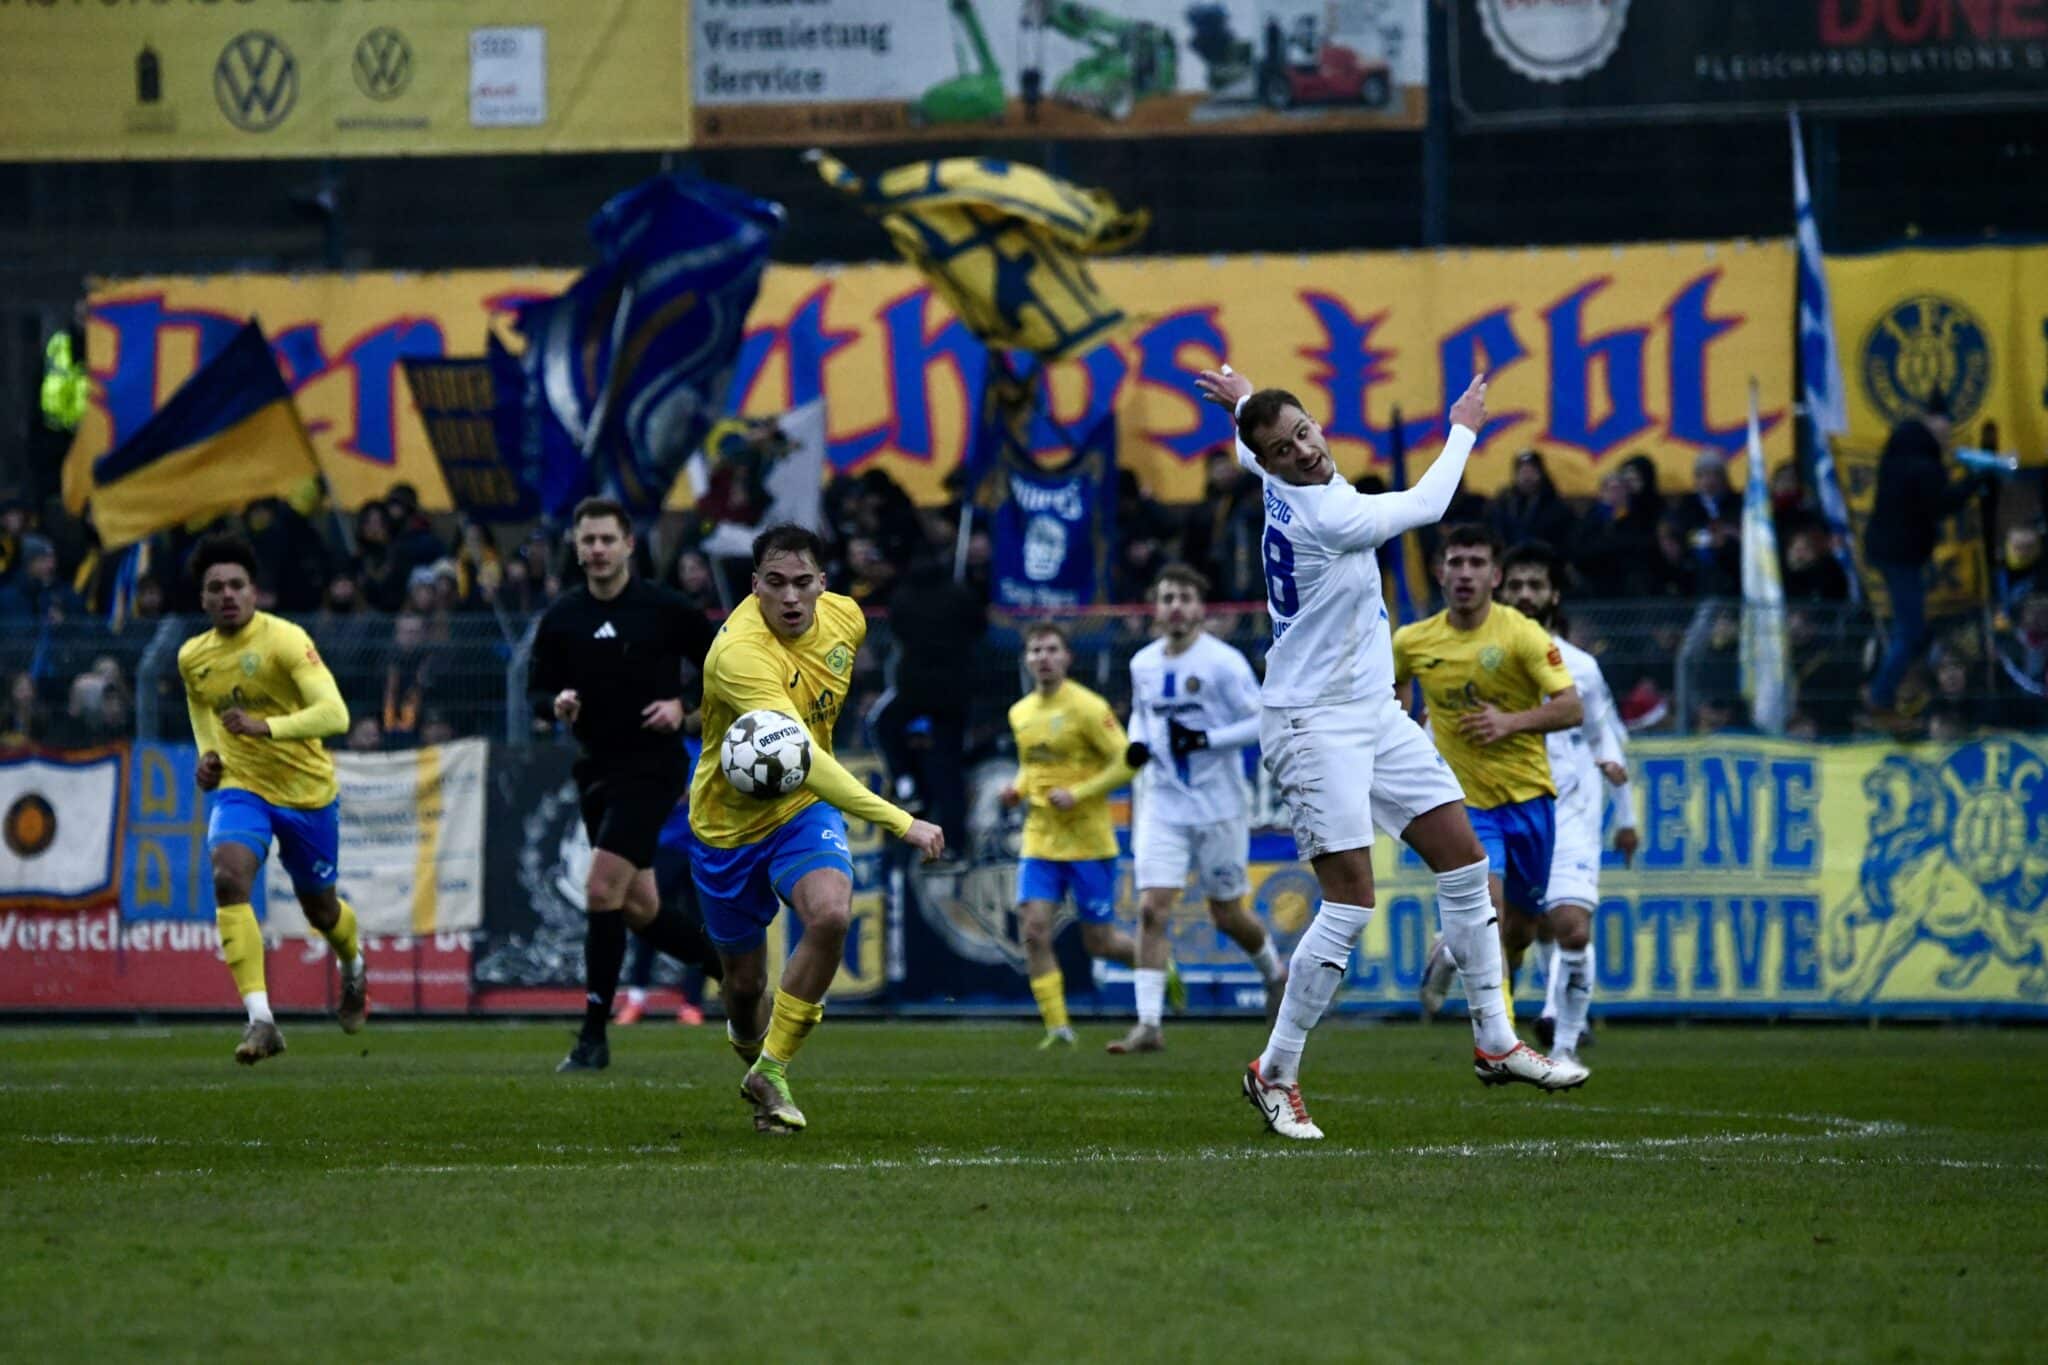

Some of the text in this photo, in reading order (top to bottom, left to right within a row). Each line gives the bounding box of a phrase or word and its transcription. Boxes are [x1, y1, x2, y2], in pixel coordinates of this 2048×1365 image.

[703, 20, 893, 56] Vermietung
[704, 65, 826, 94] Service
[1264, 524, 1300, 618] 8
